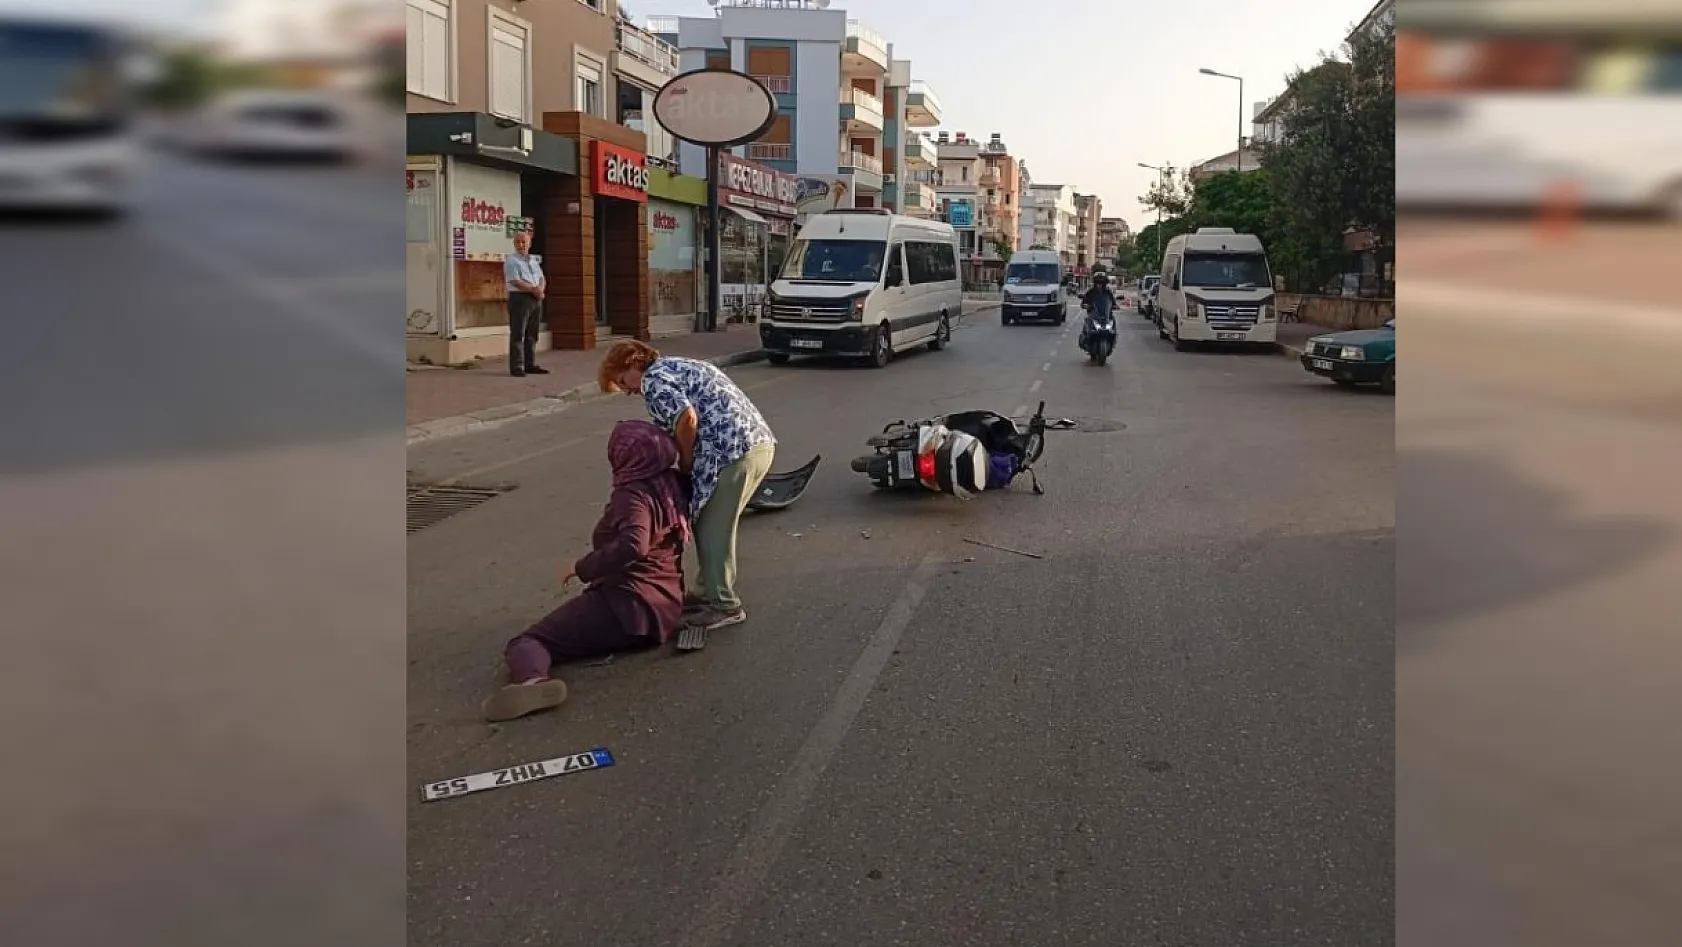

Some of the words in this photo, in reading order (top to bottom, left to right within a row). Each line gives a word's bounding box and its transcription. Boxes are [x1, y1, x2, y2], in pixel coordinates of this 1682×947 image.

[666, 90, 746, 120] akta
[563, 754, 595, 771] 07
[492, 762, 546, 786] MHZ
[432, 777, 468, 796] 55
